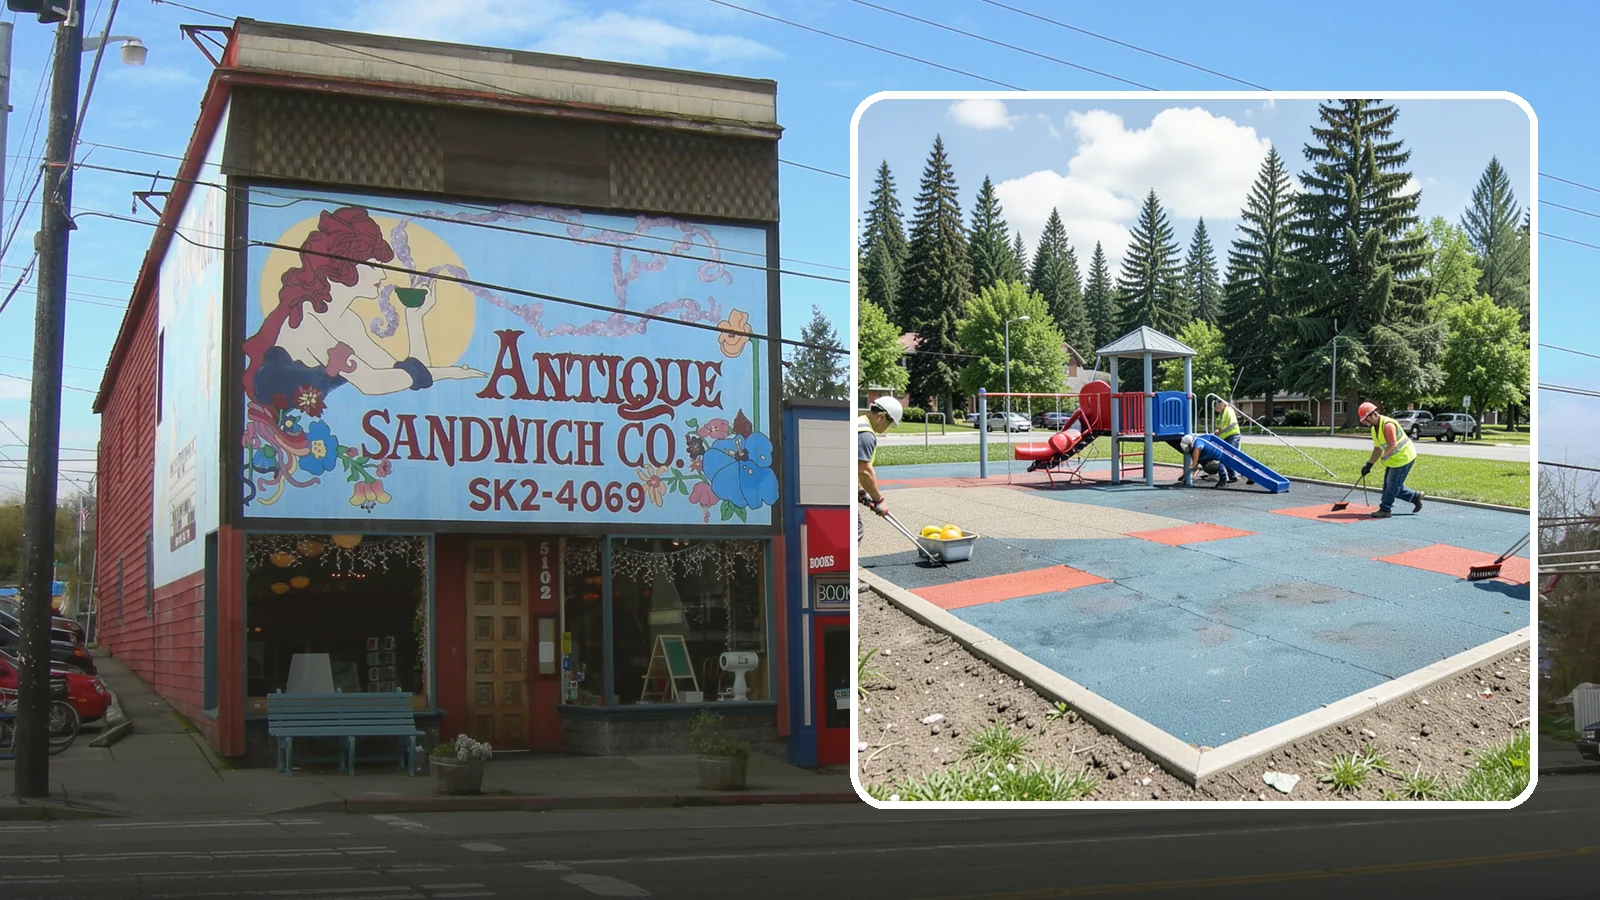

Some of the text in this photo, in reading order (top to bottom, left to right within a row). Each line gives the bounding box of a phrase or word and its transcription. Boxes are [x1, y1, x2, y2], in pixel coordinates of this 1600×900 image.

[476, 329, 723, 421] ANTIQUE
[362, 409, 685, 469] SANDWICH CO.
[468, 478, 647, 514] SK2-4069
[539, 541, 552, 600] 5102
[809, 555, 835, 569] BOOKS
